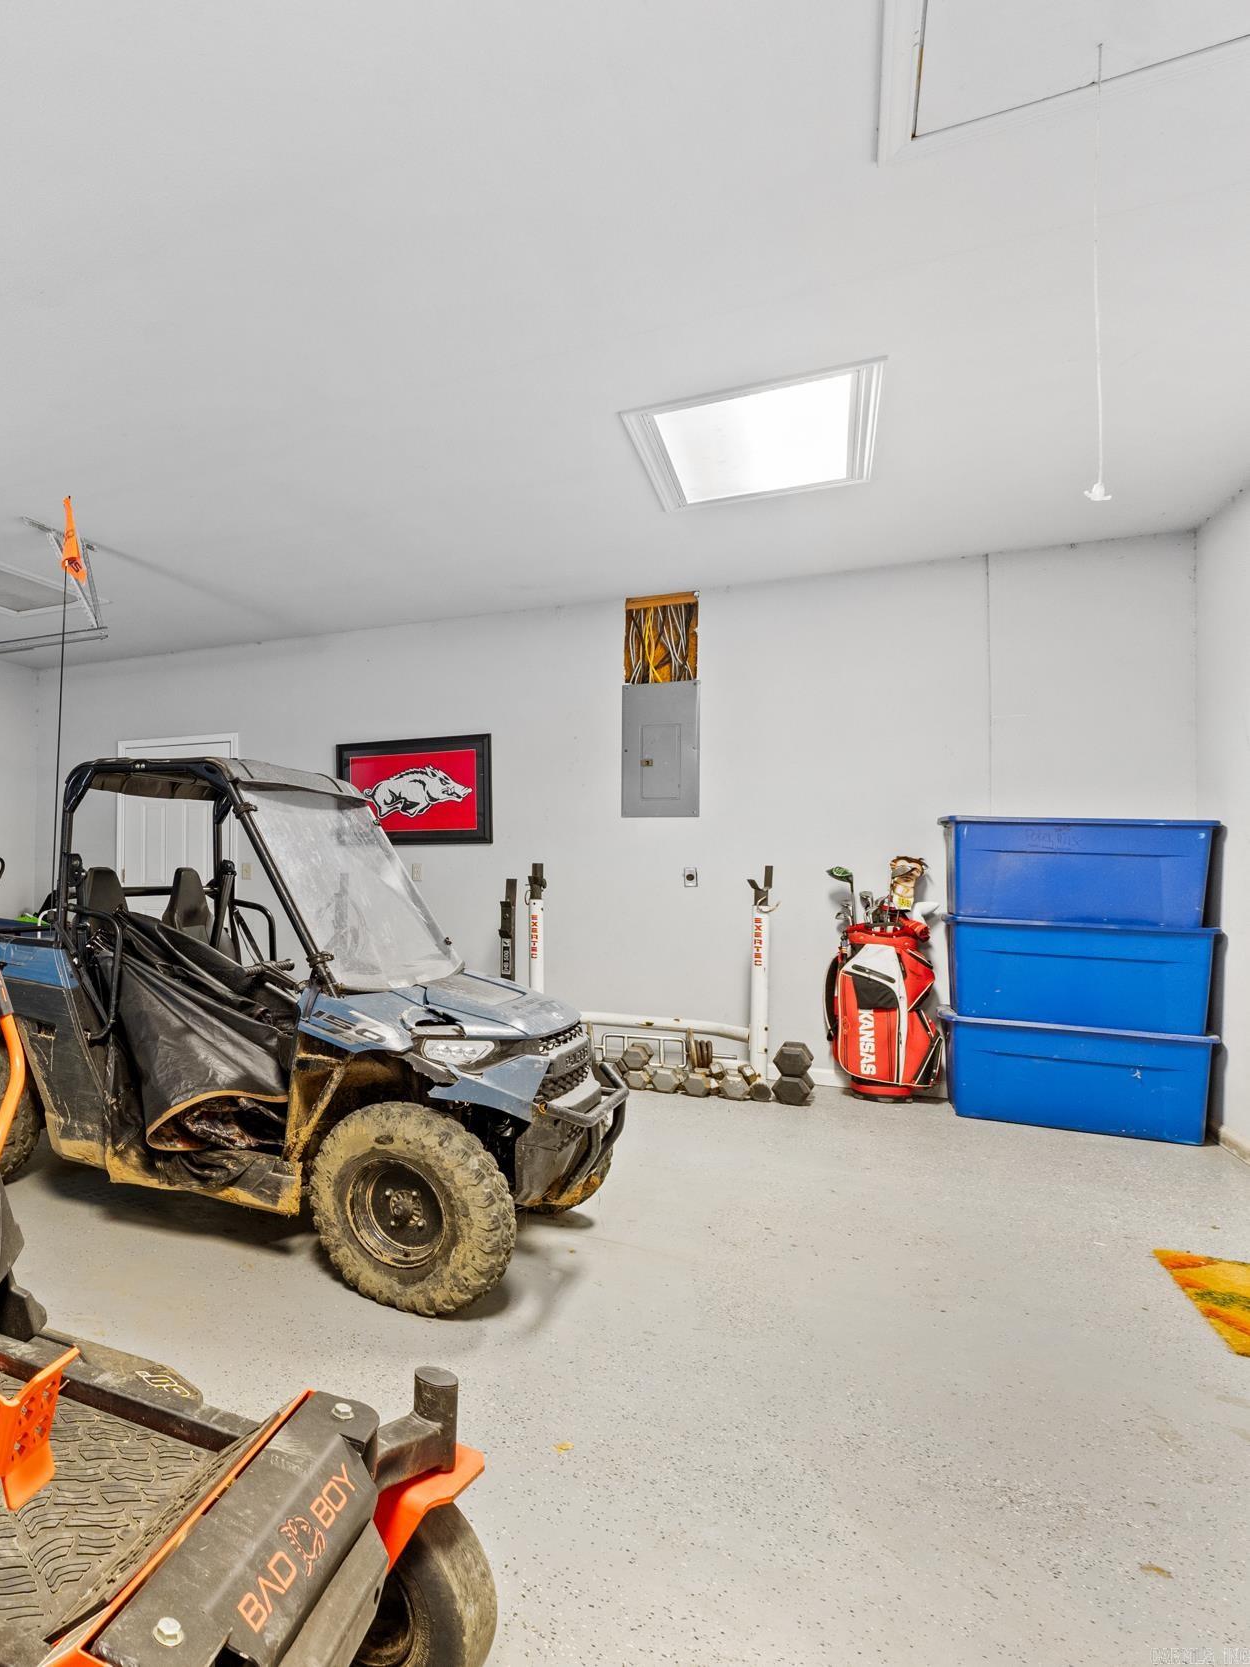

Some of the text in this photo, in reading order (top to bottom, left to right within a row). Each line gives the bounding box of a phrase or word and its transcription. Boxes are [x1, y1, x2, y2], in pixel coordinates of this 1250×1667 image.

[753, 917, 764, 968] EXERTEC
[311, 1009, 387, 1043] 150
[858, 1008, 877, 1075] KANSAS
[309, 1462, 356, 1529] BOY
[237, 1551, 297, 1633] BAD
